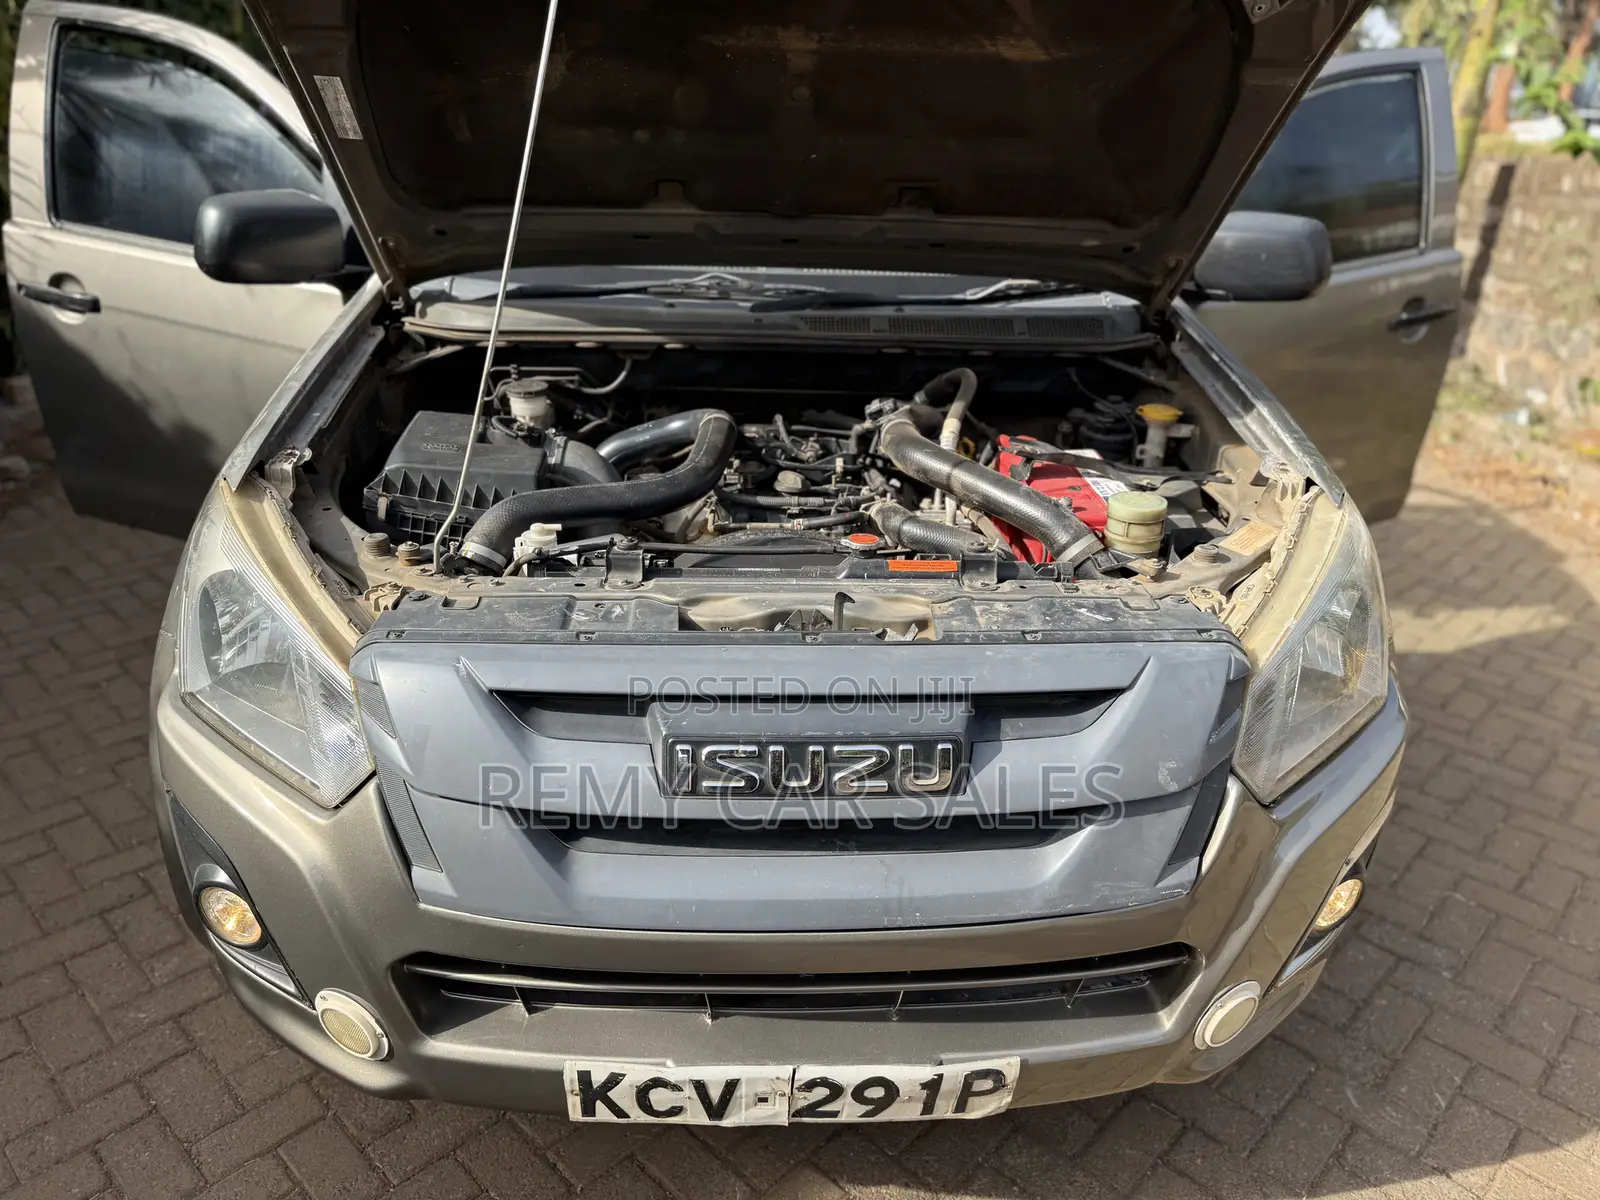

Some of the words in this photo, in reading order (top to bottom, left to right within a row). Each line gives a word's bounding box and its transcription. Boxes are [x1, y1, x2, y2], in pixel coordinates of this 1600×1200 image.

[675, 744, 954, 794] ISUZU
[576, 1069, 742, 1121] KCV
[790, 1068, 1007, 1119] 291P
